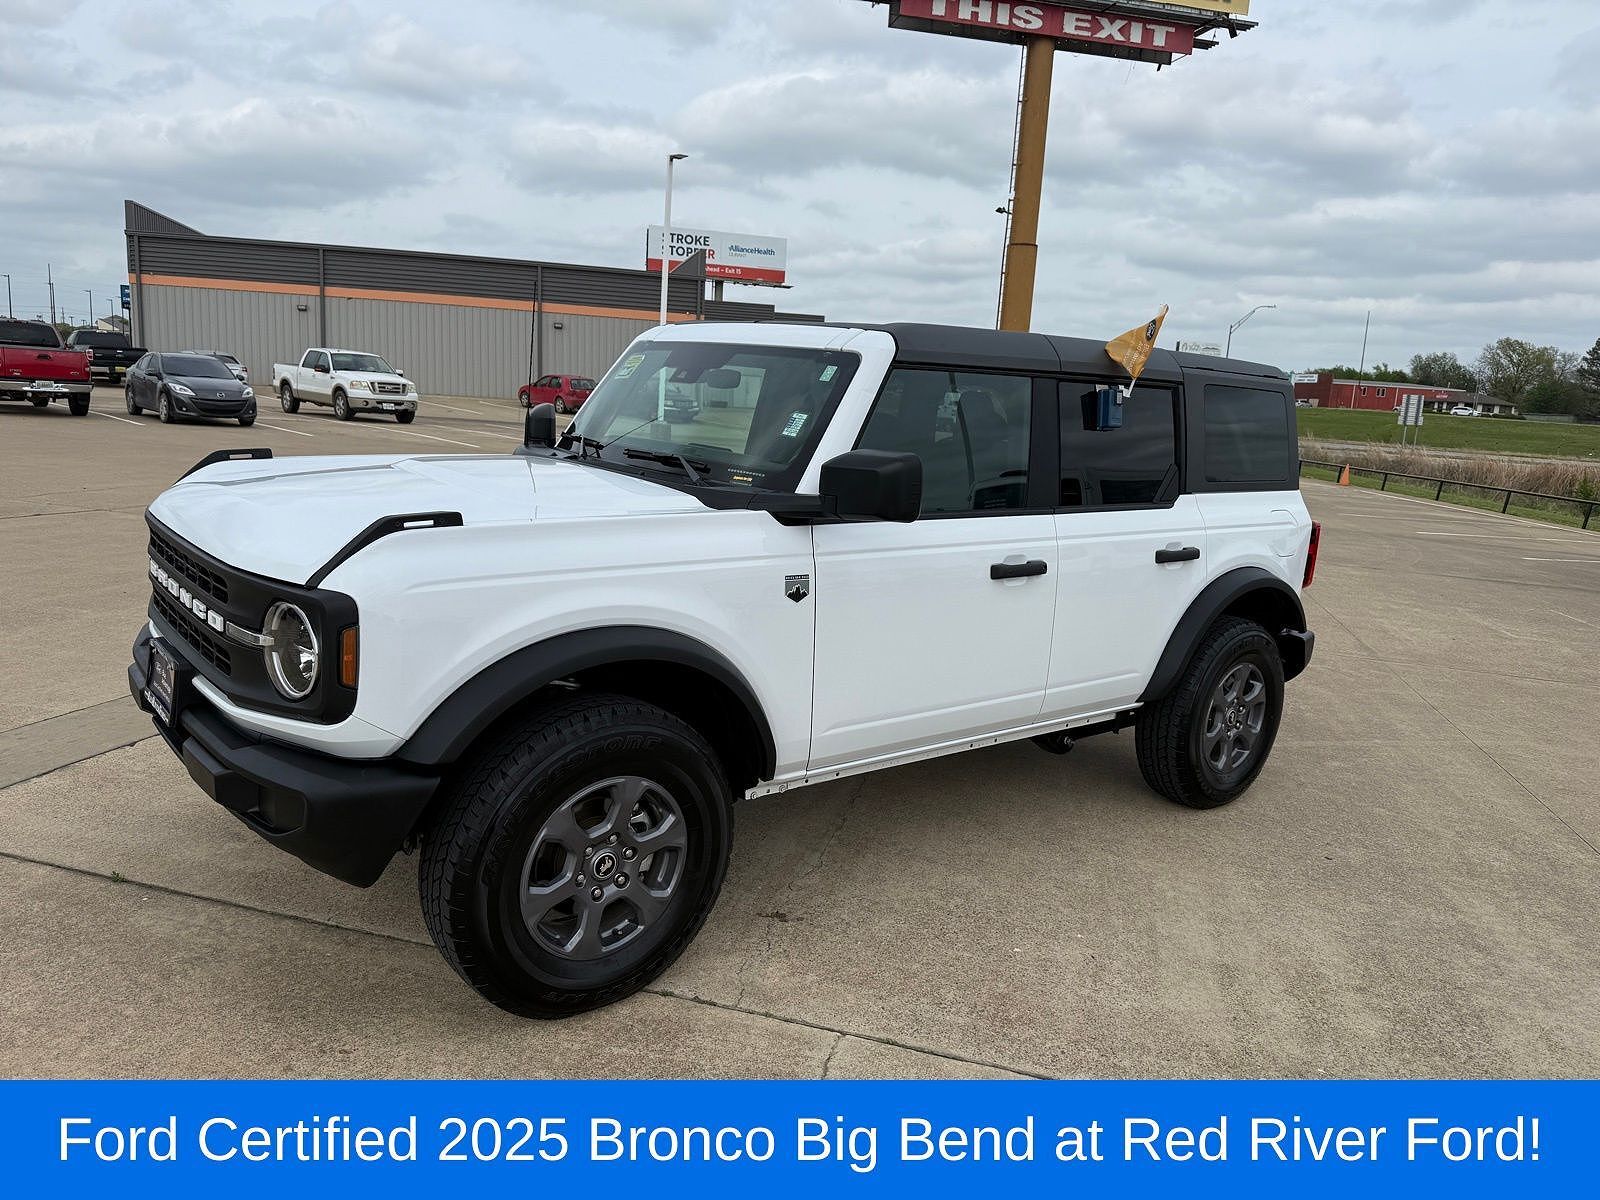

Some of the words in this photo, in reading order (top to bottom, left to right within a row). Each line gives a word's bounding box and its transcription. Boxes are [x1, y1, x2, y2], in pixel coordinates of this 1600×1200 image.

[1062, 11, 1176, 47] EXIT
[661, 232, 710, 247] TROKE
[661, 245, 715, 260] TOPR
[728, 244, 776, 256] AllianceHealth
